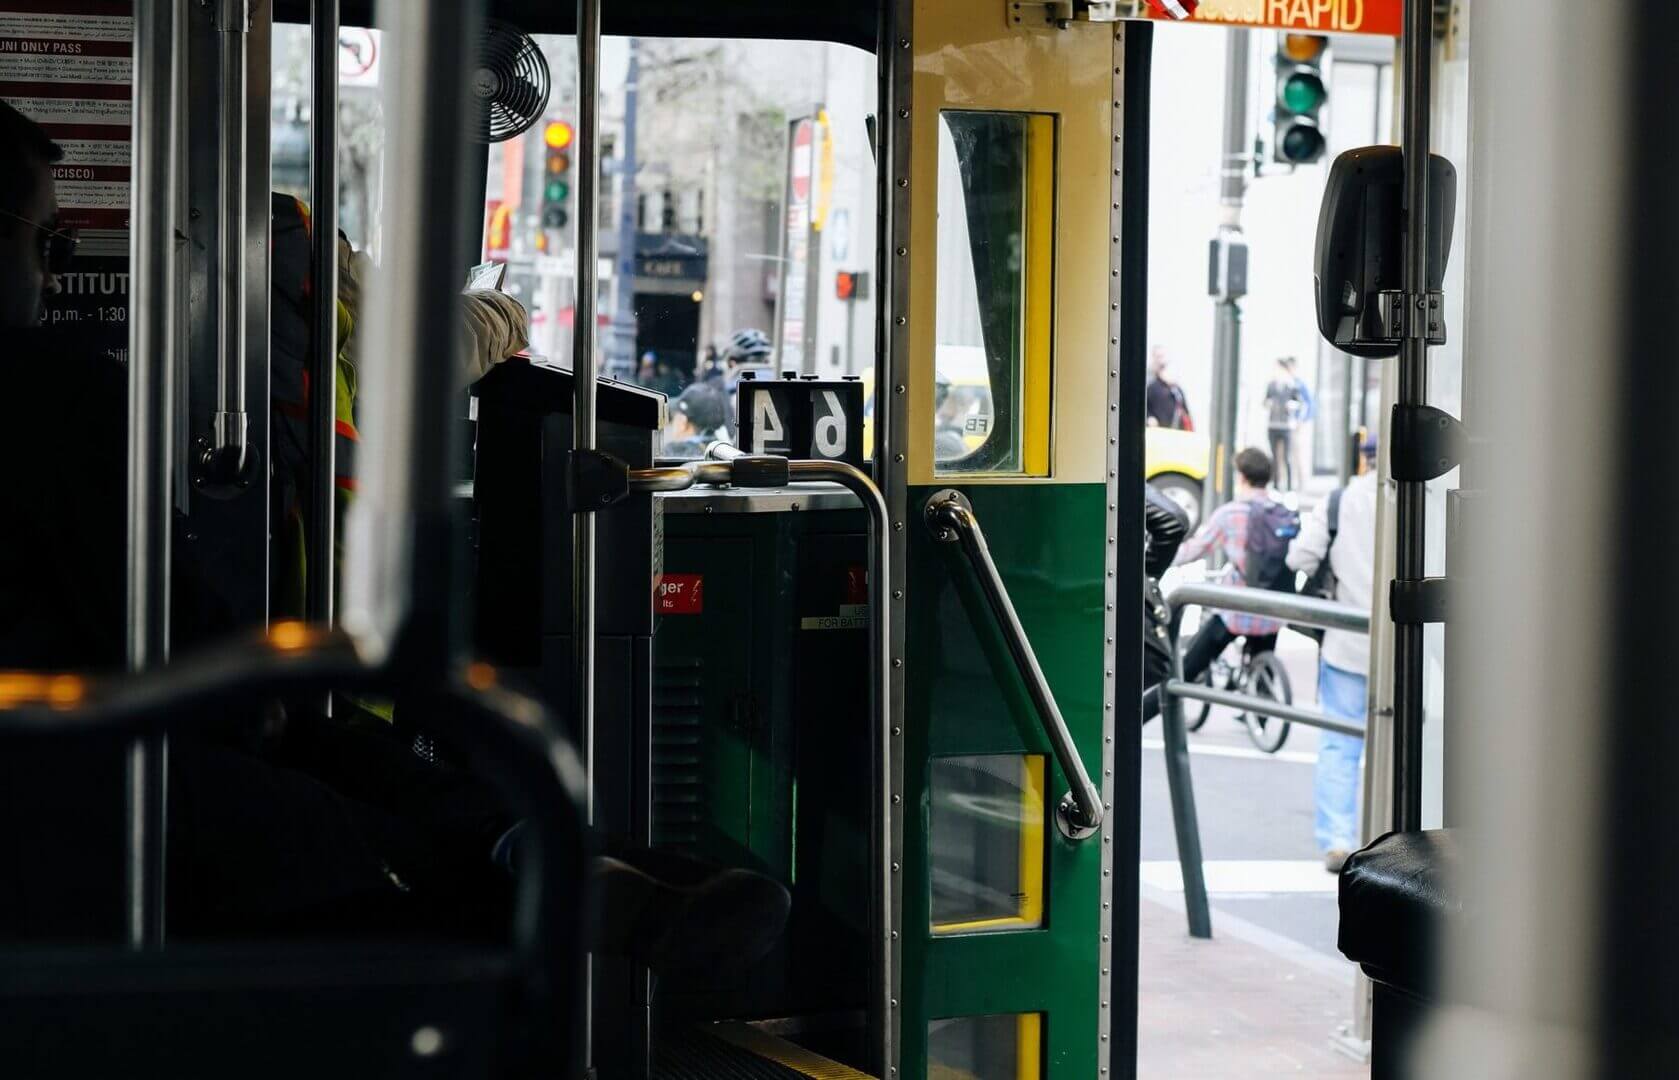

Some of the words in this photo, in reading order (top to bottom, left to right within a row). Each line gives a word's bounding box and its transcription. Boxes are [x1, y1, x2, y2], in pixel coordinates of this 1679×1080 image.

[1268, 0, 1364, 31] RAPID
[20, 41, 51, 53] ONLY
[53, 42, 82, 54] PASS
[52, 309, 83, 325] p.m.
[97, 306, 126, 322] 1:30
[817, 618, 838, 628] FOR
